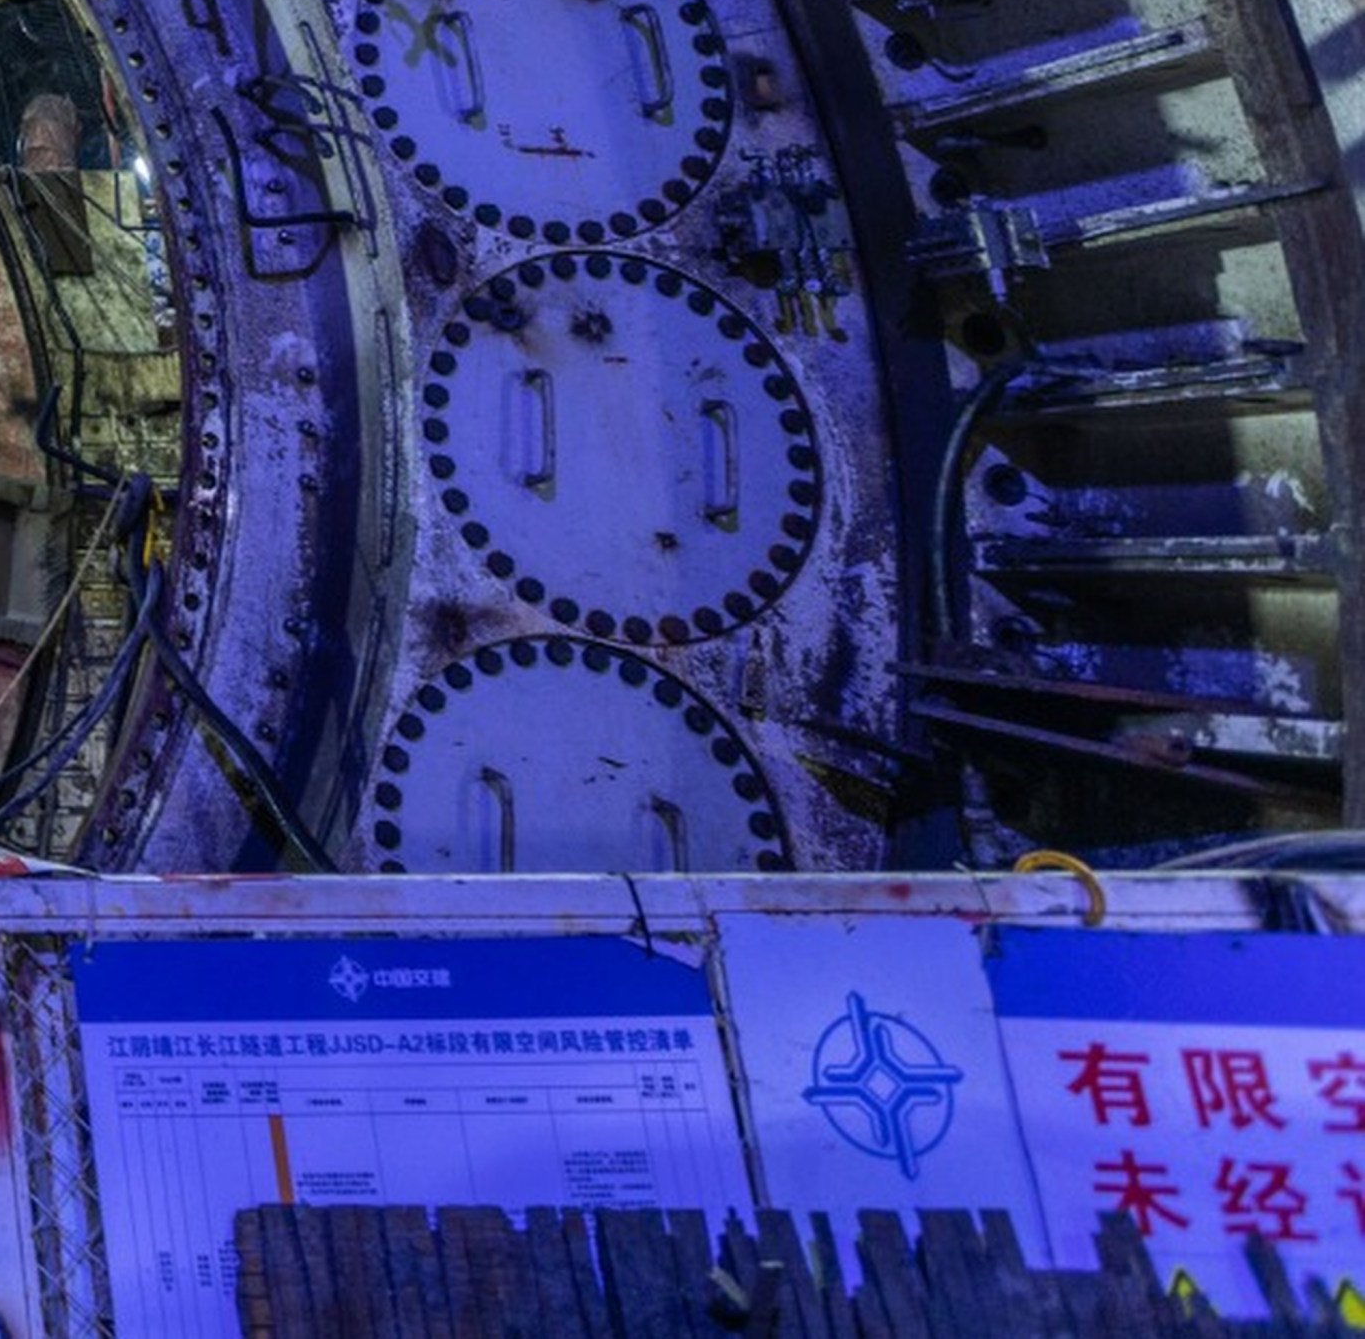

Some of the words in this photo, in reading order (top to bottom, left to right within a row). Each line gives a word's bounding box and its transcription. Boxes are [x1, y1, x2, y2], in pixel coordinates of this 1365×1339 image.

[373, 968, 451, 988] 中国交建
[1093, 1151, 1365, 1241] 未经
